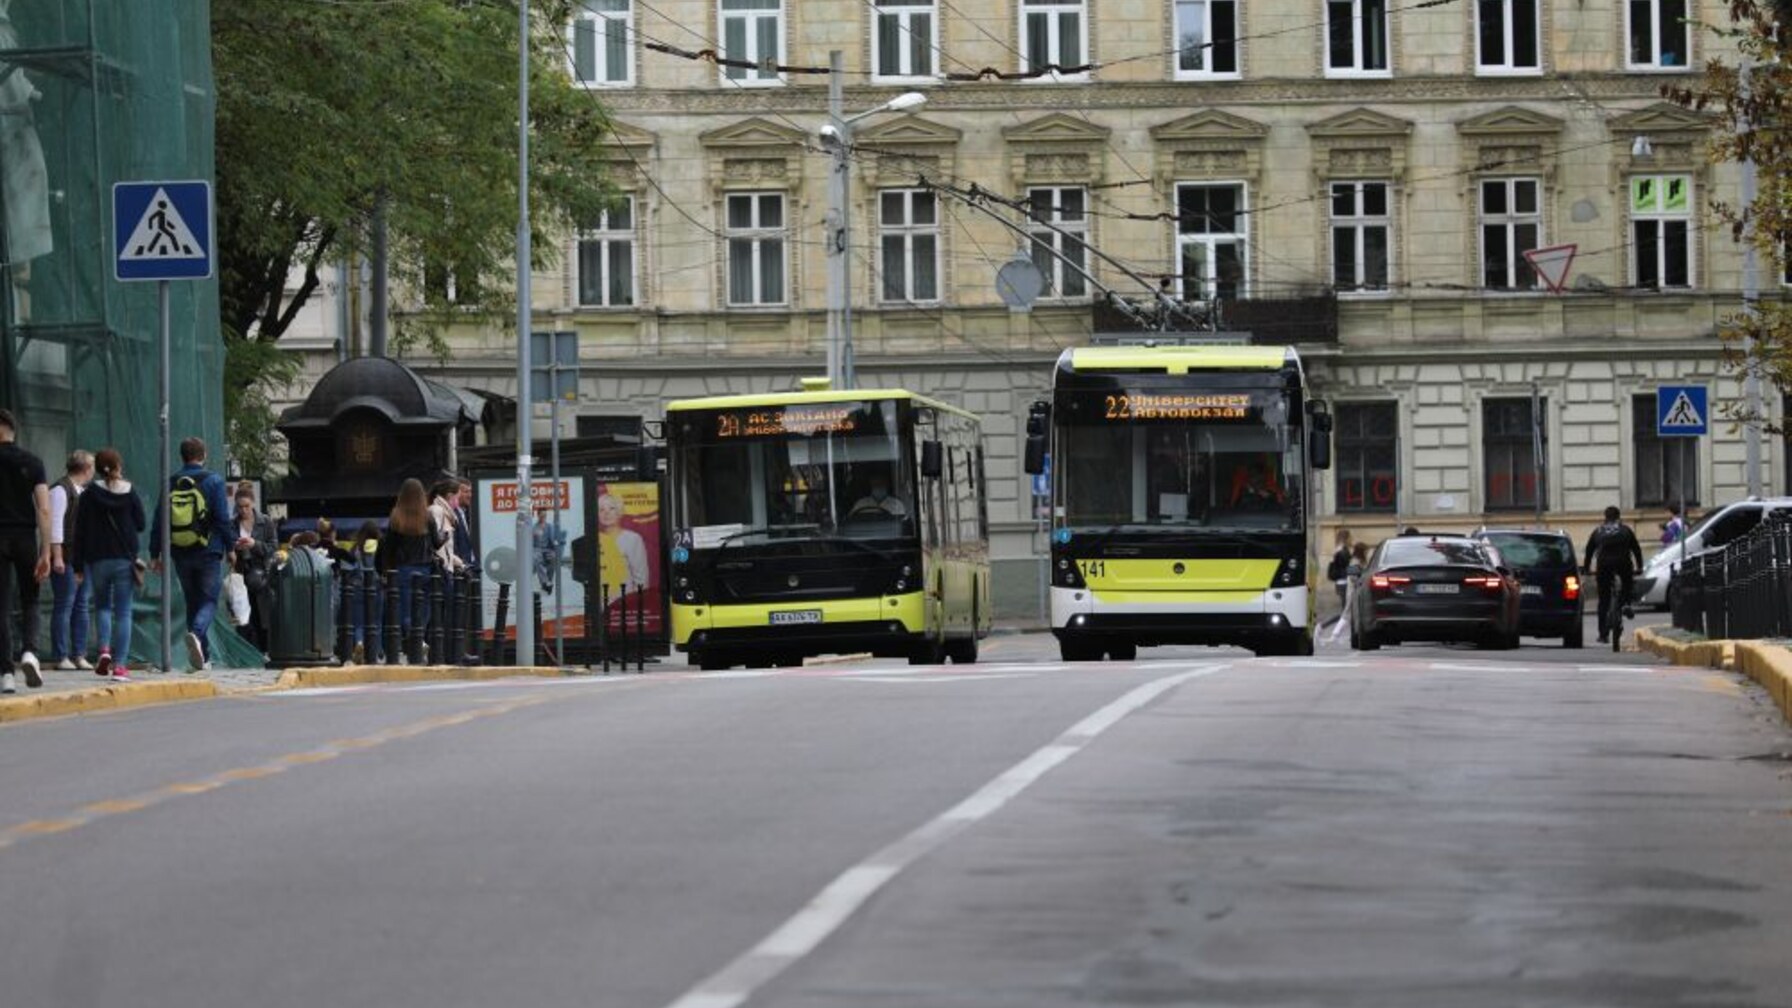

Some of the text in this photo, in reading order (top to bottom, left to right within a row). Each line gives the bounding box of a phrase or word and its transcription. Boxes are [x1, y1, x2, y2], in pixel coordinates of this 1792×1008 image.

[1105, 395, 1129, 418] 22
[1131, 395, 1249, 406] Університет
[1081, 560, 1105, 578] 141
